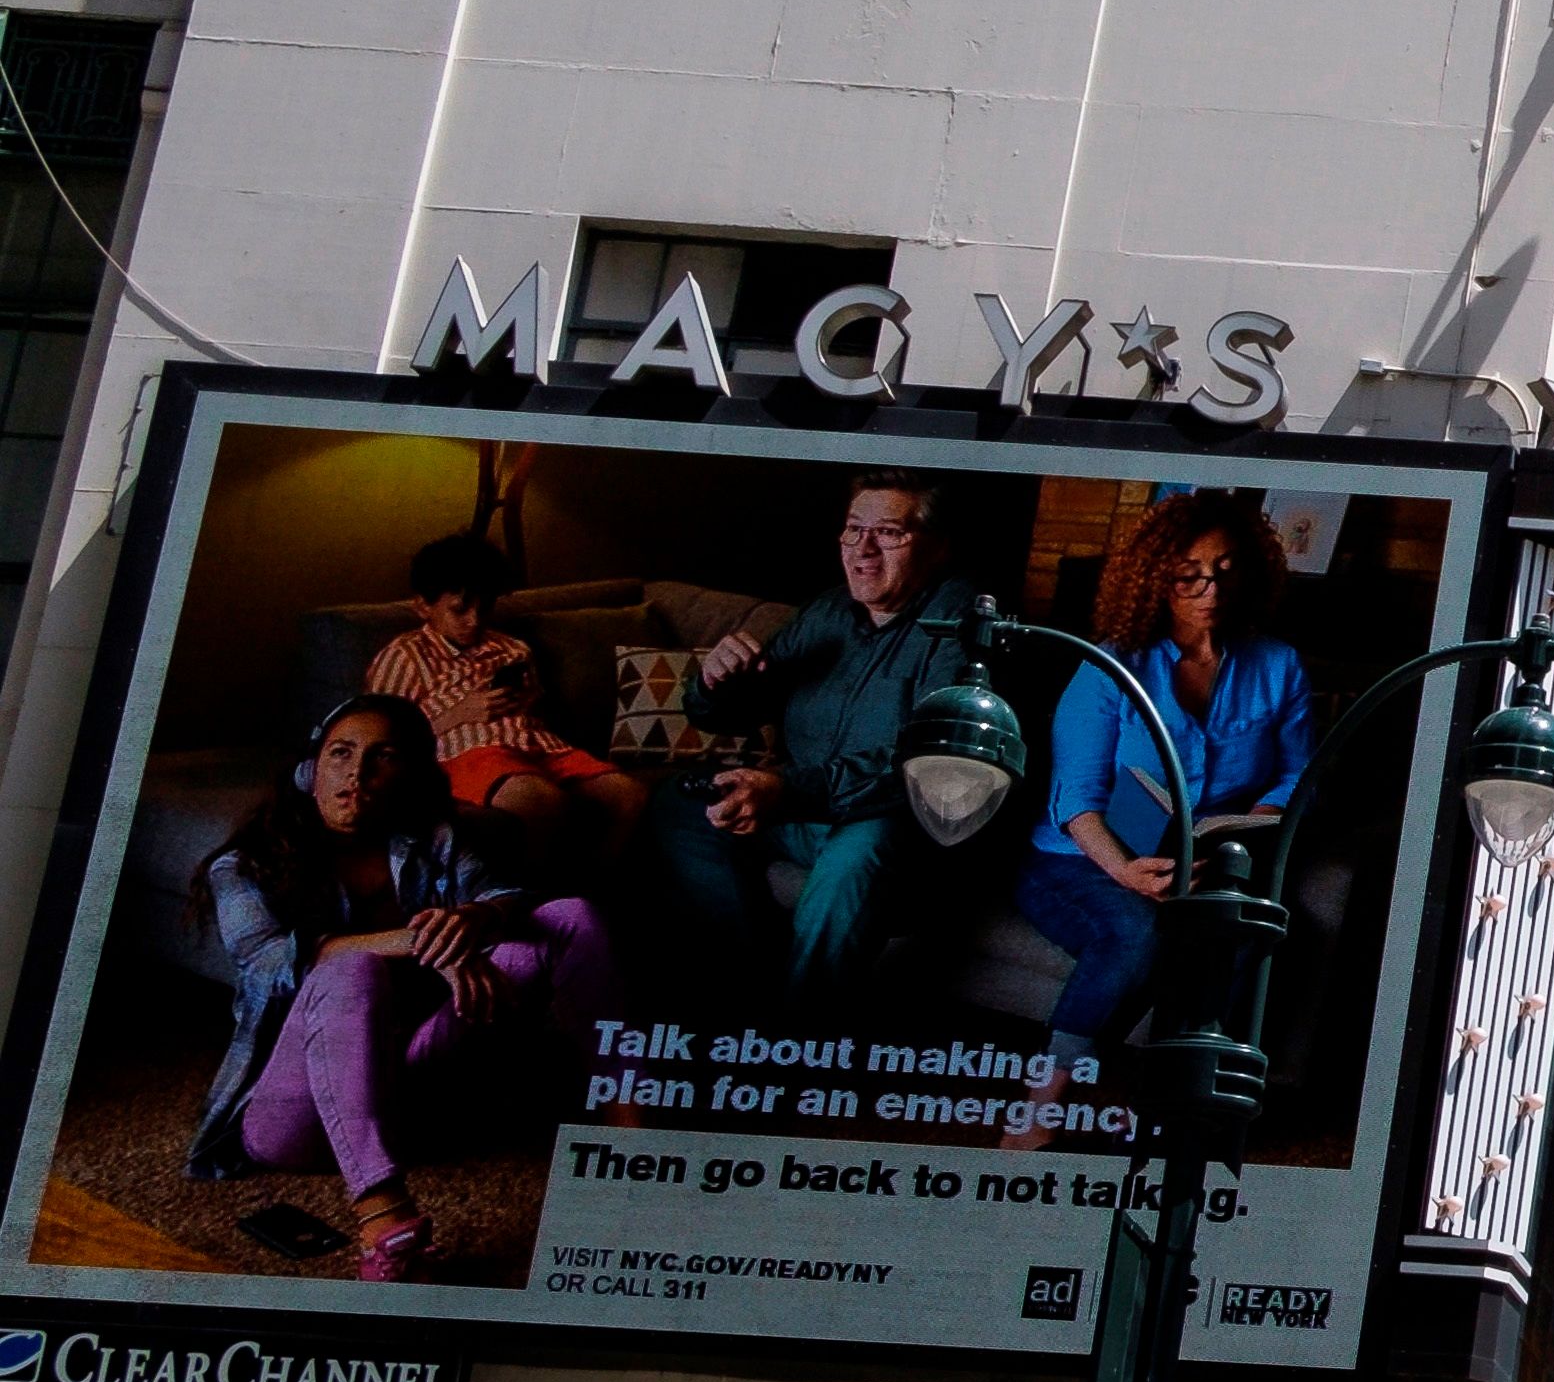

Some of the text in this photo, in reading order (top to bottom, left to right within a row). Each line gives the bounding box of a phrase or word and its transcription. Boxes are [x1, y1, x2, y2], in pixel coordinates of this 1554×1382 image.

[594, 1019, 1099, 1088] Talk about making a
[585, 1069, 696, 1110] plan
[711, 1075, 785, 1113] for
[797, 1087, 859, 1118] an
[570, 1143, 1248, 1222] Then go back to not talkg.
[552, 1246, 893, 1284] VISIT NYC.GOV/READYNY
[547, 1274, 707, 1300] OR CALL 311
[1029, 1274, 1075, 1305] ad
[1227, 1287, 1329, 1311] READY
